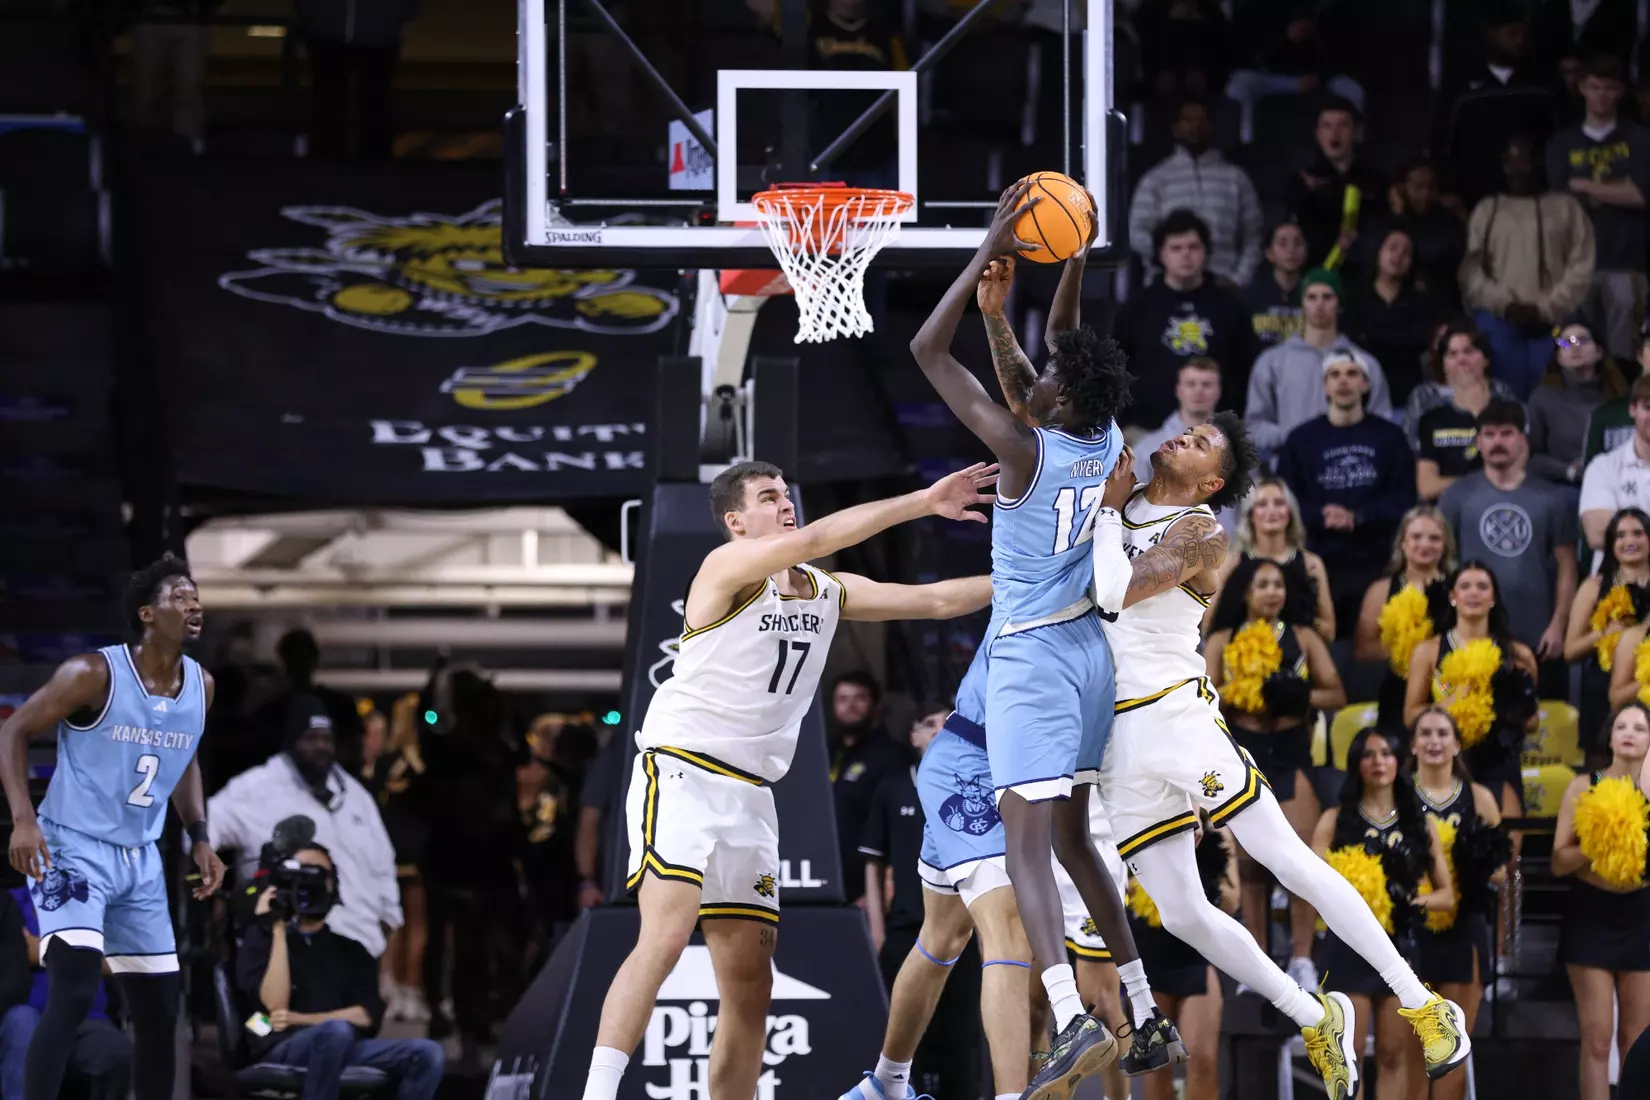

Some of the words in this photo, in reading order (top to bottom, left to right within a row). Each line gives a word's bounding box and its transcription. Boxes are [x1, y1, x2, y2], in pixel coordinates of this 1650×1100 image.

[545, 231, 602, 244] SPALDING
[1052, 480, 1107, 556] 12
[767, 639, 811, 695] 17
[111, 724, 162, 747] KANSAS
[163, 731, 194, 751] CITY
[126, 753, 160, 808] 2
